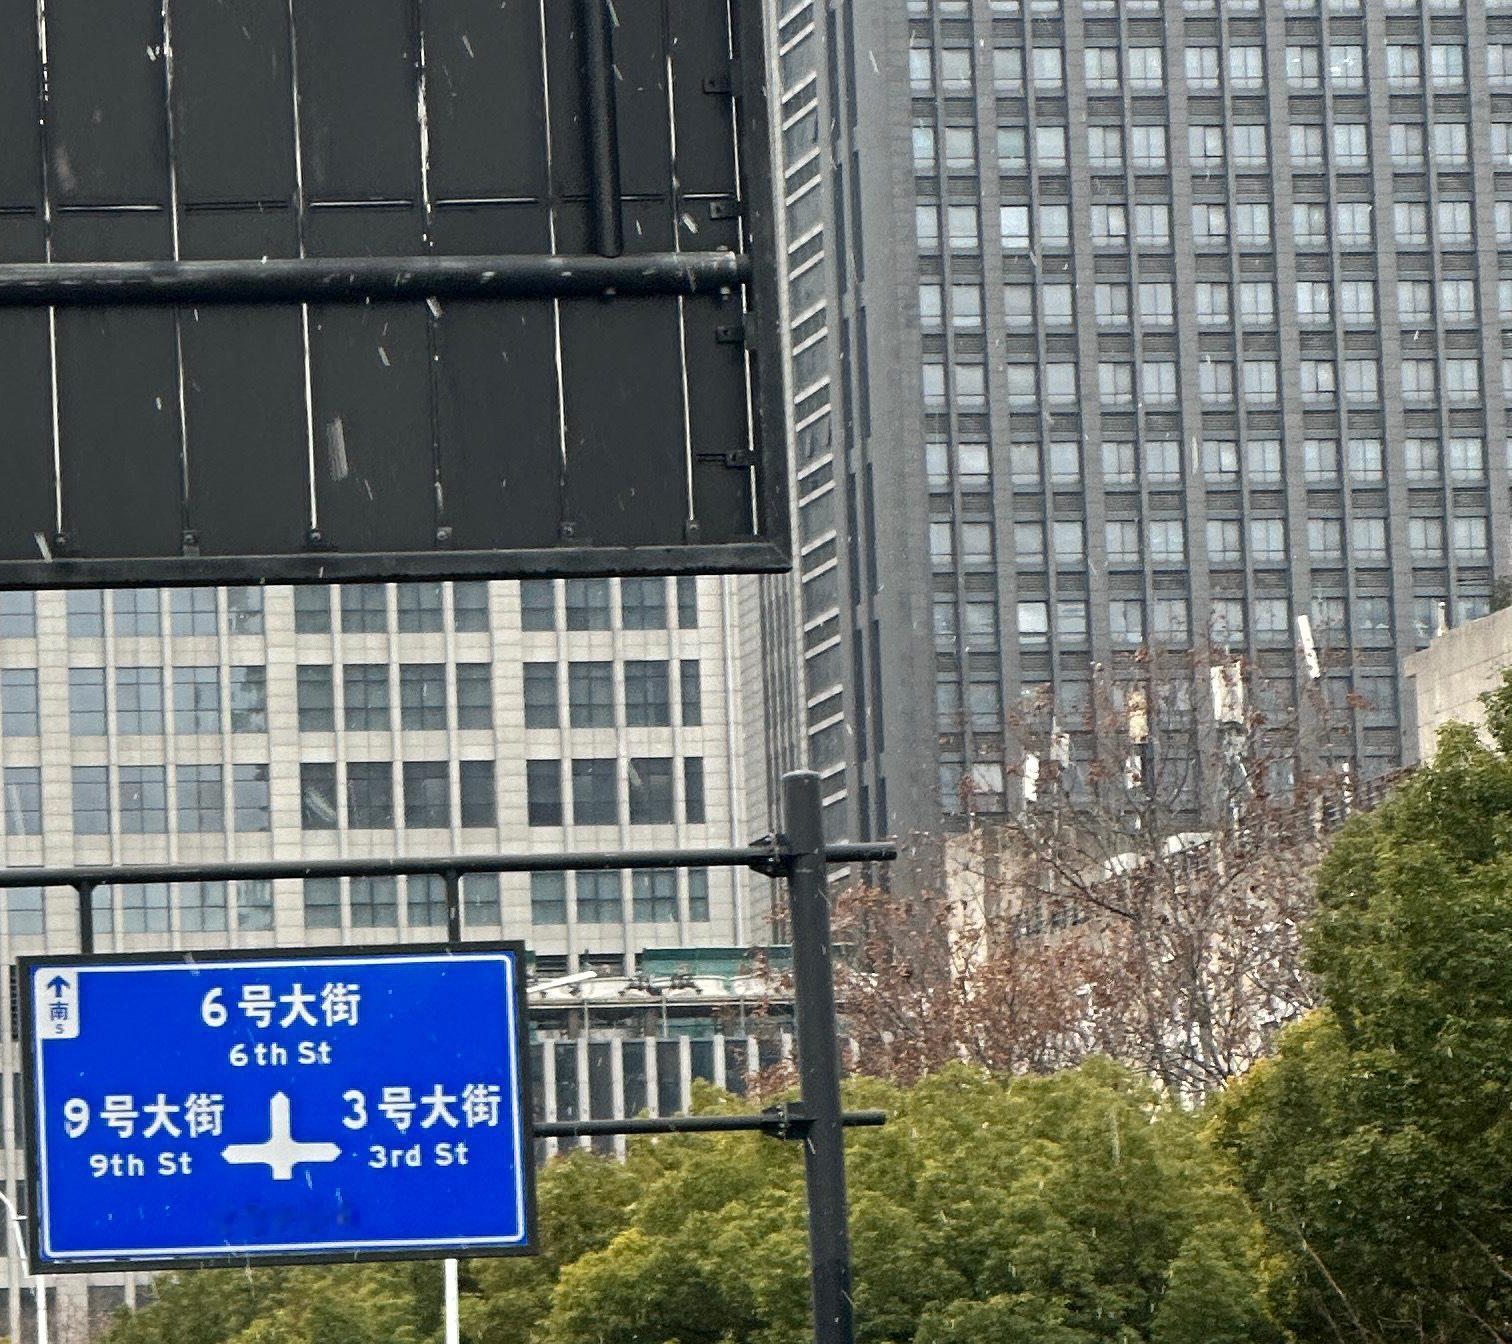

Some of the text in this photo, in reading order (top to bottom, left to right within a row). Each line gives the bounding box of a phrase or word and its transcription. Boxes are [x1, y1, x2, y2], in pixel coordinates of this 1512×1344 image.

[49, 1001, 69, 1021] 南
[202, 983, 360, 1029] 6号大街
[55, 1023, 65, 1035] S
[230, 1042, 331, 1066] 6th St
[64, 1094, 223, 1139] 9号大街
[343, 1084, 501, 1130] 3号大街
[90, 1152, 192, 1177] 9th St
[369, 1143, 469, 1168] 3rd St
